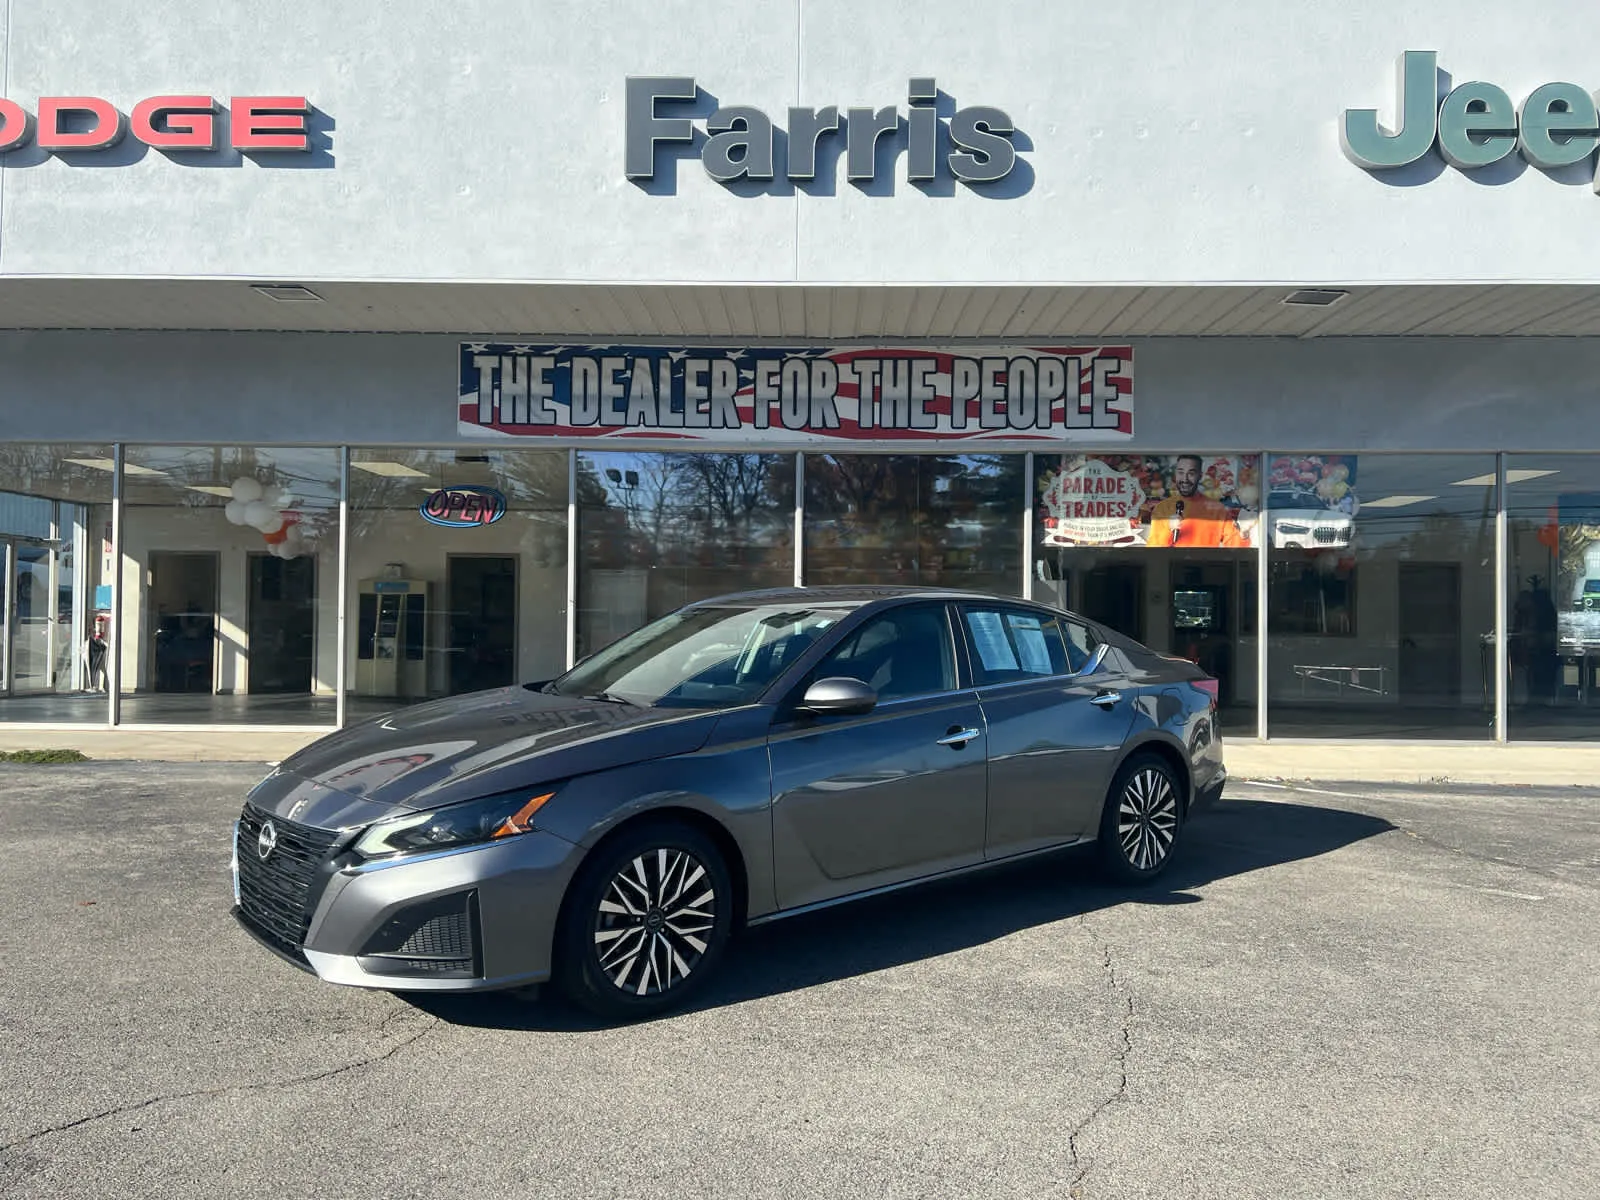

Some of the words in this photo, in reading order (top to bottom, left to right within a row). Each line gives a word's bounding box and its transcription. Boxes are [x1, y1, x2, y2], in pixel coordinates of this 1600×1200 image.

[625, 76, 1016, 181] Farris
[1343, 50, 1600, 168] Jee
[472, 354, 557, 426] THE
[569, 355, 742, 430] DEALER
[752, 357, 840, 431] FOR
[851, 356, 938, 430] THE
[950, 356, 1122, 431] PEOPLE
[428, 489, 497, 525] OPEN
[1062, 477, 1127, 494] PARADE
[1062, 501, 1127, 518] TRADES
